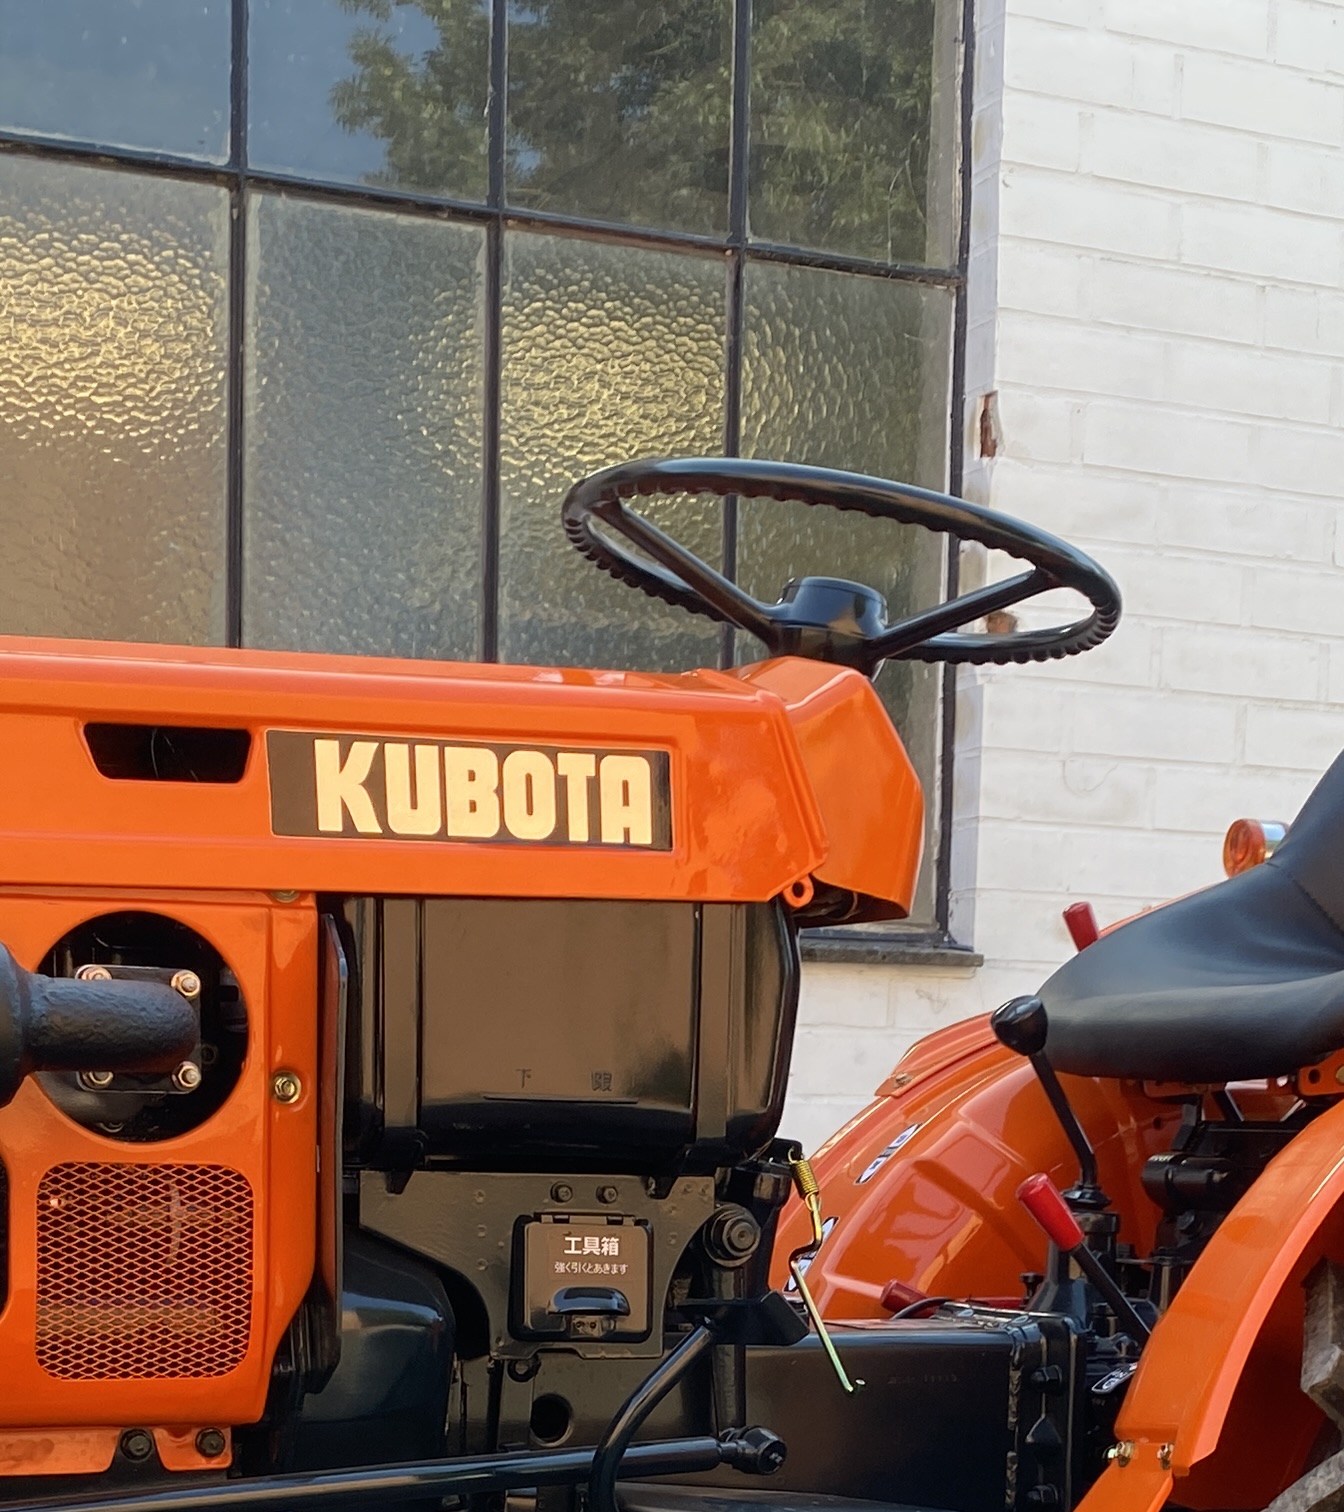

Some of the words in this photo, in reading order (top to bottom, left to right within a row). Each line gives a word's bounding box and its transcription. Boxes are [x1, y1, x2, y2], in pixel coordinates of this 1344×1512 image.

[314, 738, 652, 844] KUBOTA
[564, 1237, 619, 1256] 工具箱
